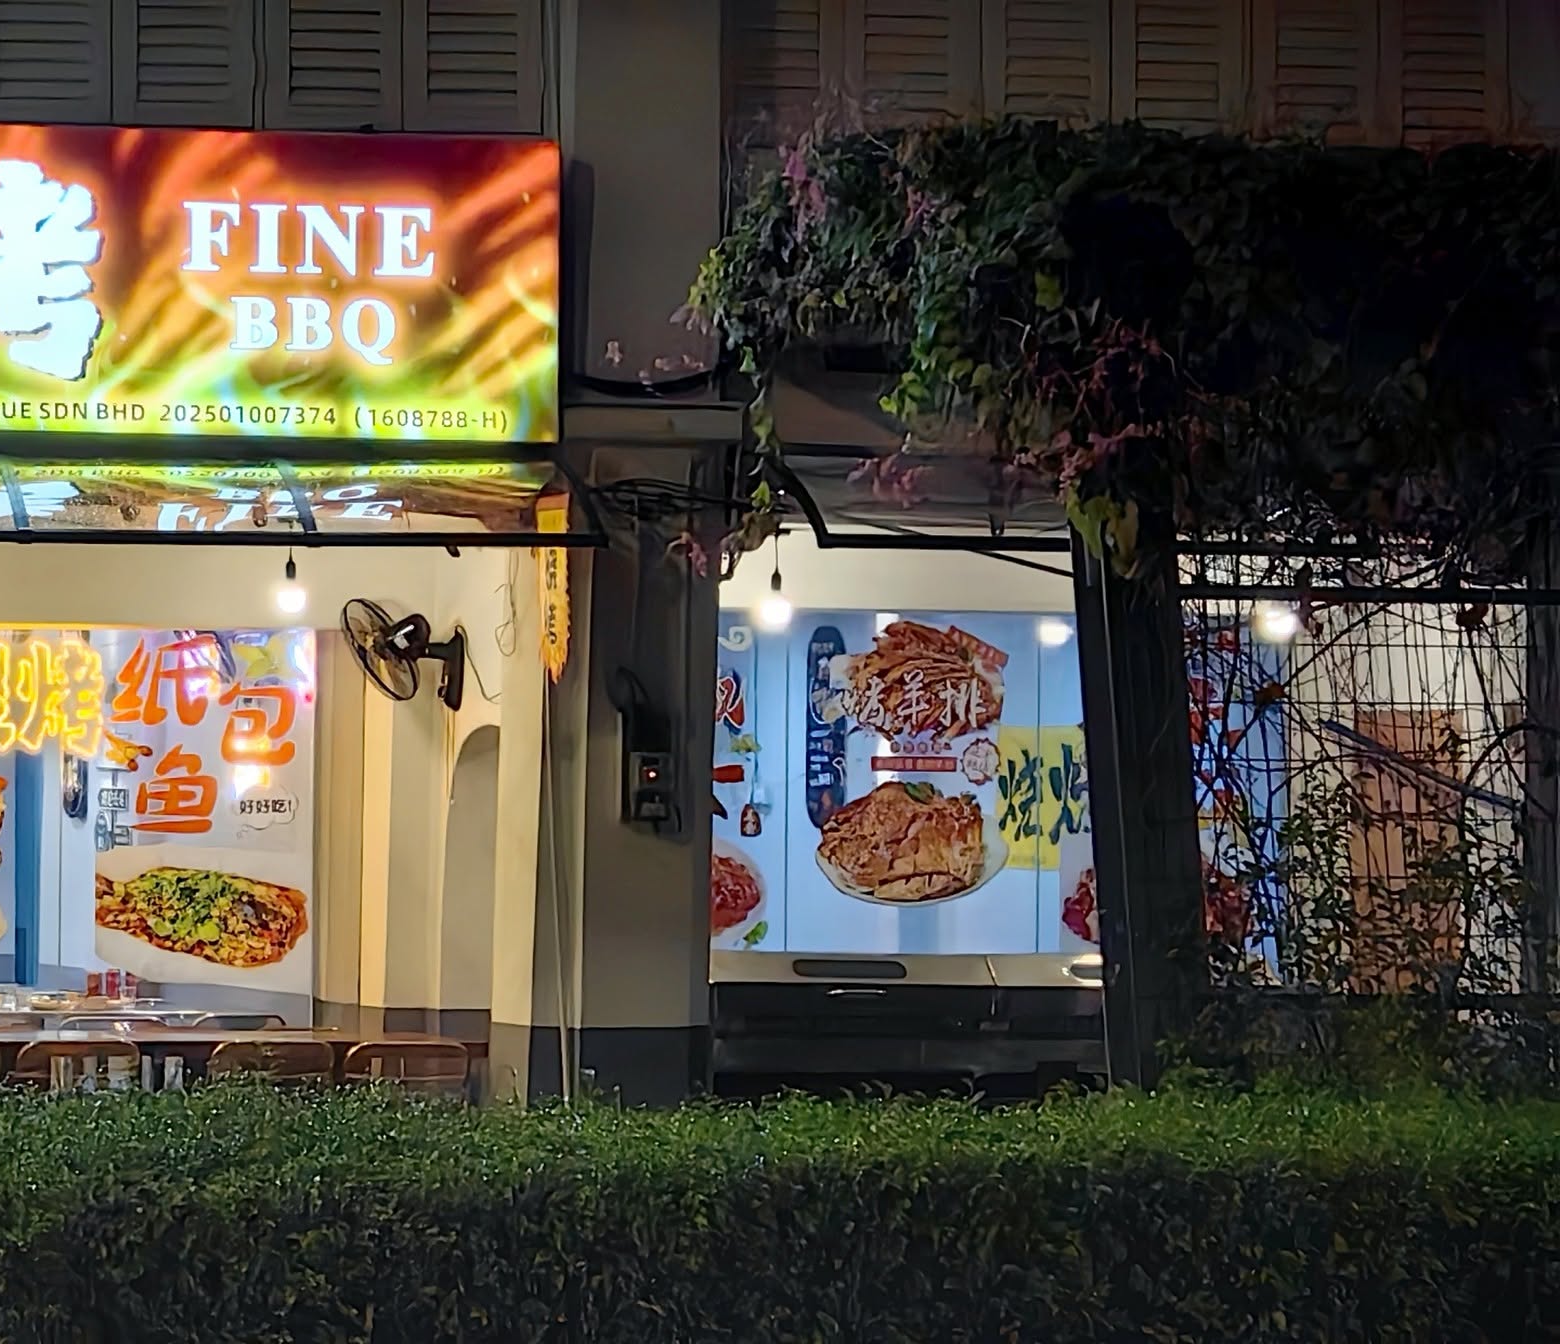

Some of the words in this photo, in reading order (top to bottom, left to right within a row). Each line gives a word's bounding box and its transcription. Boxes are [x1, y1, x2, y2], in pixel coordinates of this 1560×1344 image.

[181, 200, 436, 278] FINE
[229, 295, 397, 365] BBQ
[39, 402, 88, 420] SDN
[96, 404, 145, 421] BHD
[159, 404, 336, 425] 202501007374
[354, 406, 508, 433] (1608788-H)
